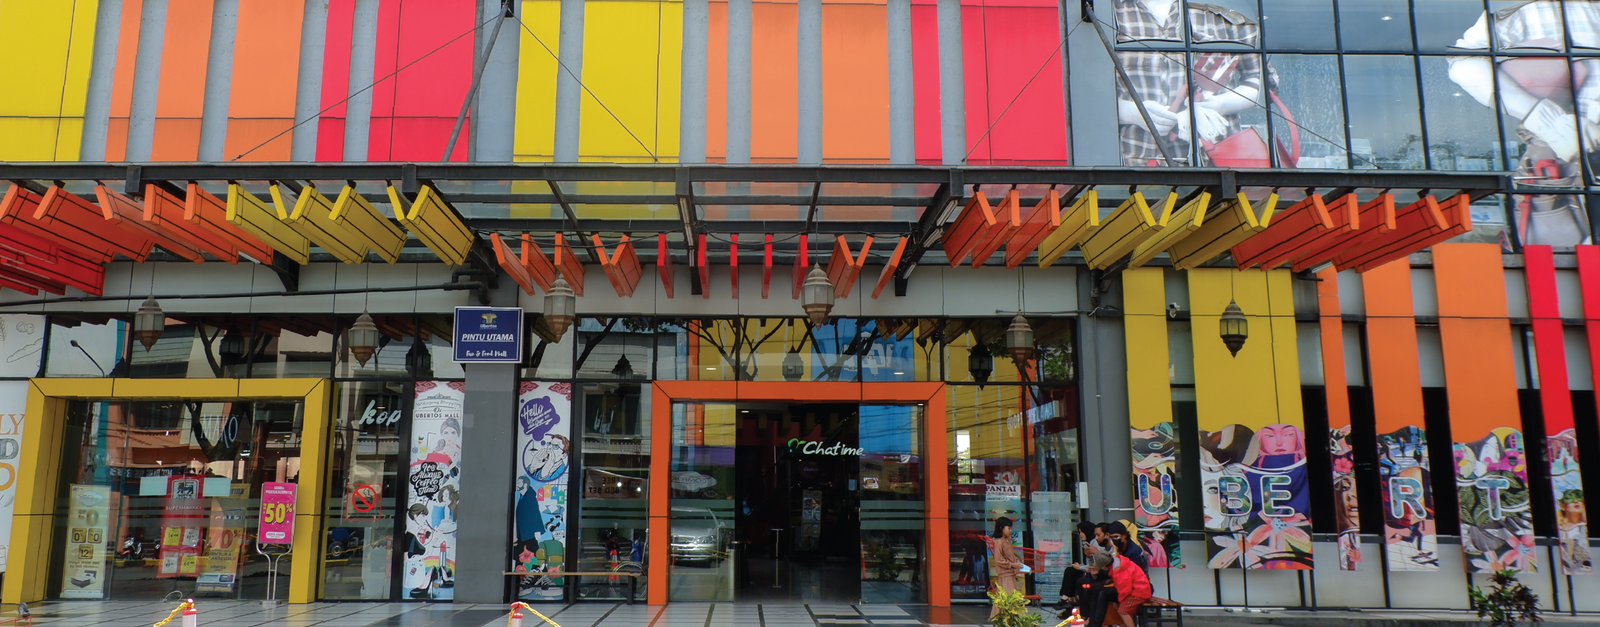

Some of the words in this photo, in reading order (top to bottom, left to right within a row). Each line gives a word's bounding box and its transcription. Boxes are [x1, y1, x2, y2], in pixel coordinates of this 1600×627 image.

[462, 333, 485, 341] PINTU
[487, 333, 514, 341] UTAMA
[495, 350, 507, 358] Mall
[520, 403, 544, 425] Hello
[803, 441, 864, 456] Chatime
[412, 471, 441, 481] Always
[986, 484, 1016, 492] PANTAI
